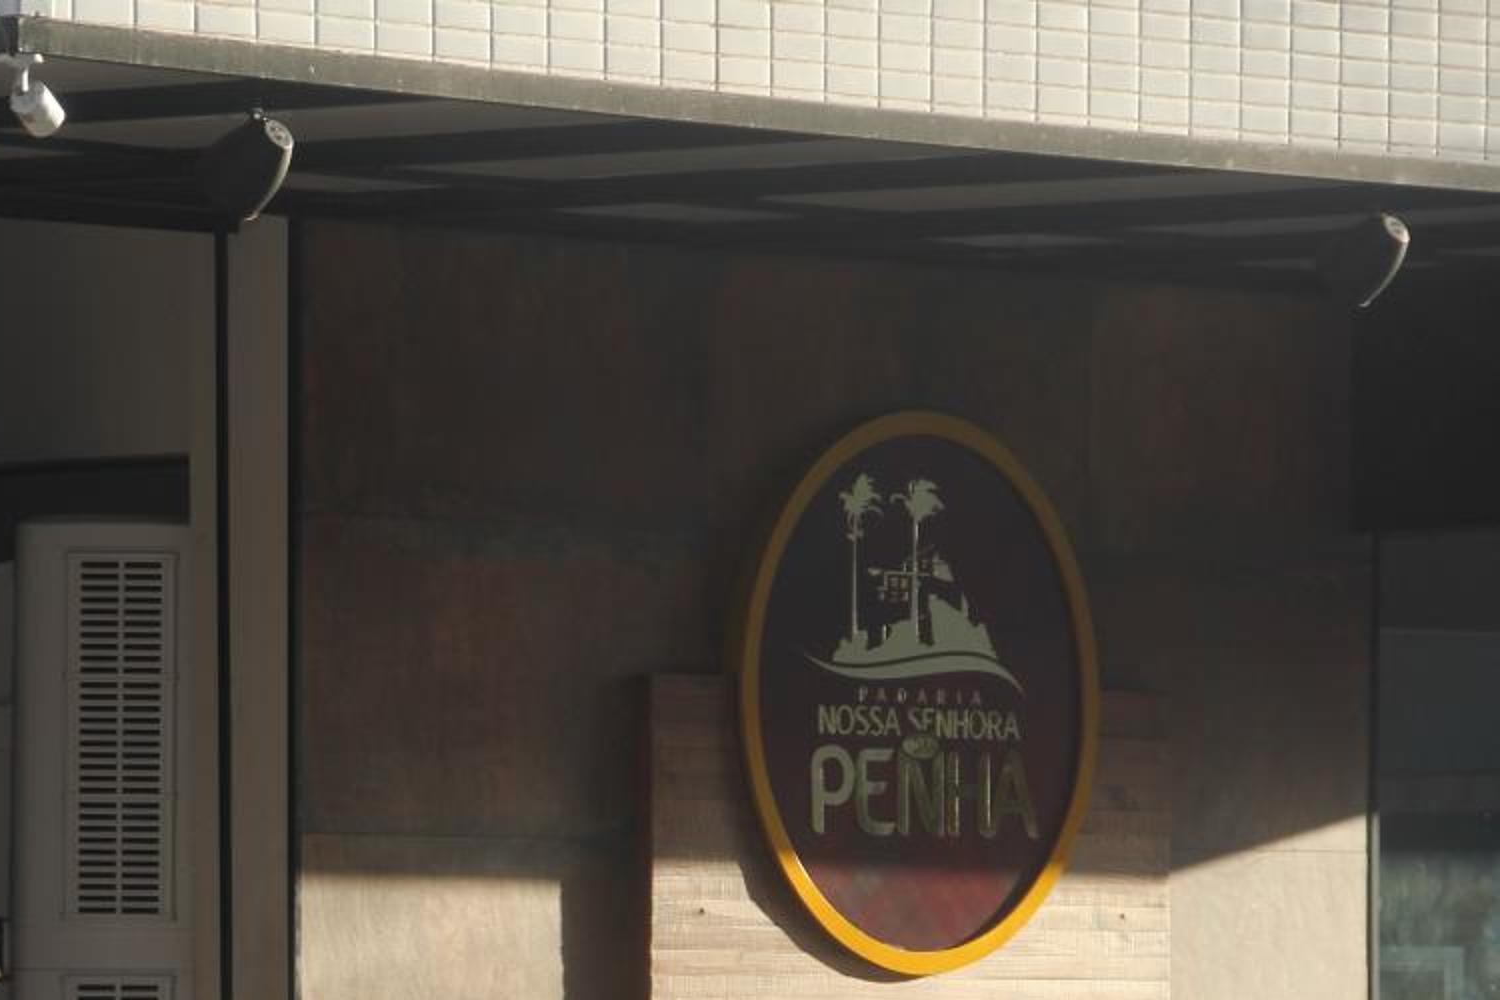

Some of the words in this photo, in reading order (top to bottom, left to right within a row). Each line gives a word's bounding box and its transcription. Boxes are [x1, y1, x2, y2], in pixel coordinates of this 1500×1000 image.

[857, 686, 983, 704] PADARIA
[818, 703, 901, 736] NOSSA
[906, 706, 1022, 741] SENHORA
[810, 743, 1040, 839] PENHA
